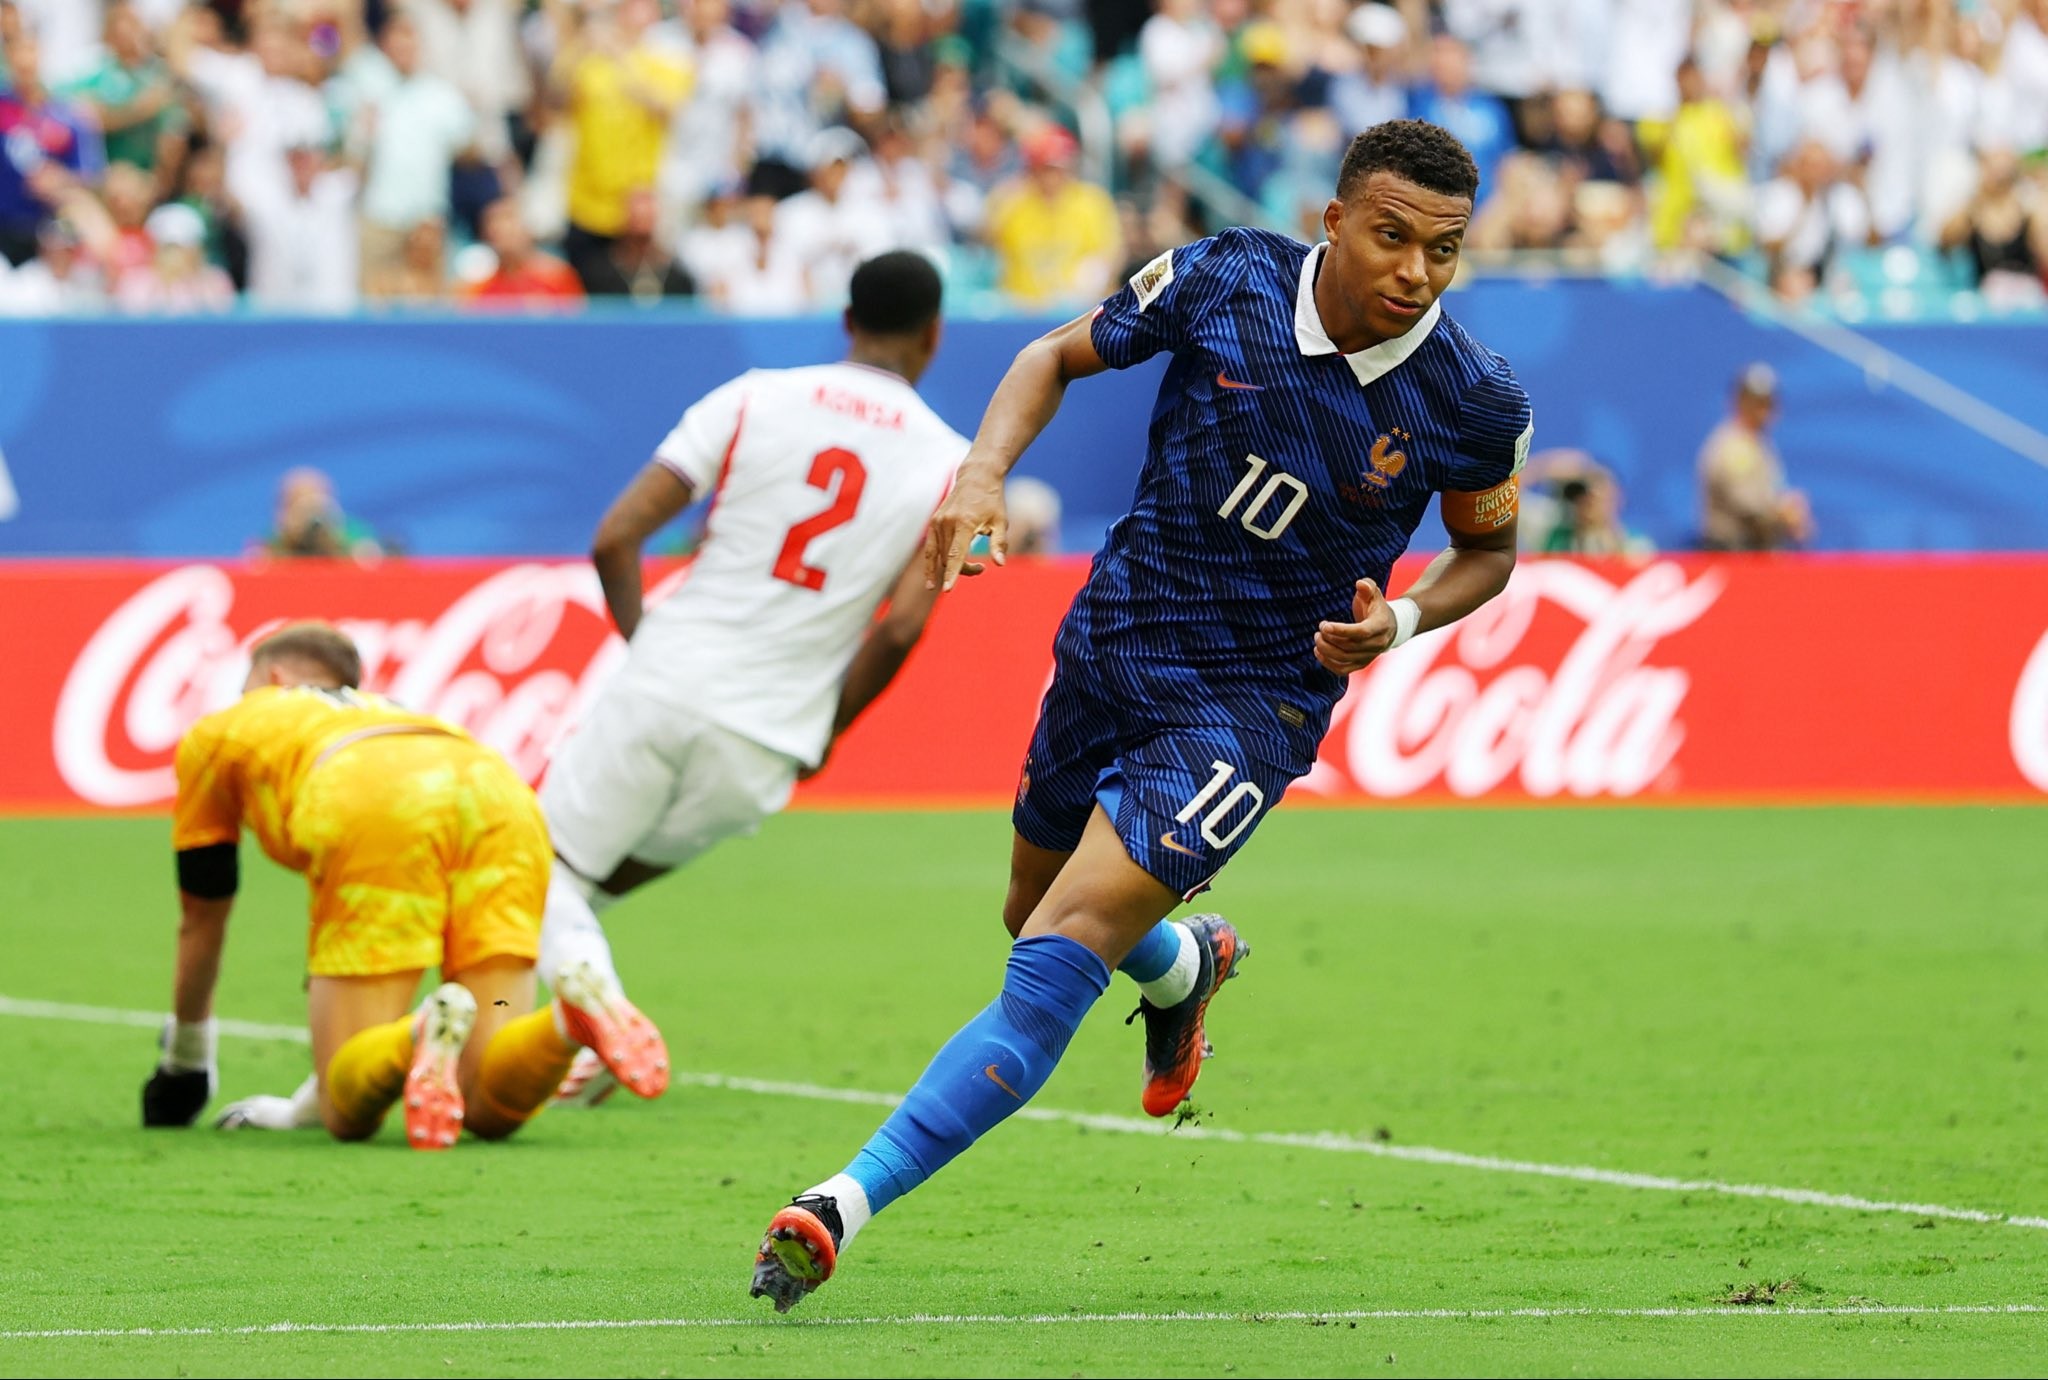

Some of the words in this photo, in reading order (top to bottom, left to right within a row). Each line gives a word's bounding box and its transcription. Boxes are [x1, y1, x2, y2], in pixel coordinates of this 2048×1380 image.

[771, 447, 868, 592] 2
[1217, 453, 1309, 540] 10
[1475, 485, 1517, 514] UNITES
[1174, 758, 1264, 850] 10
